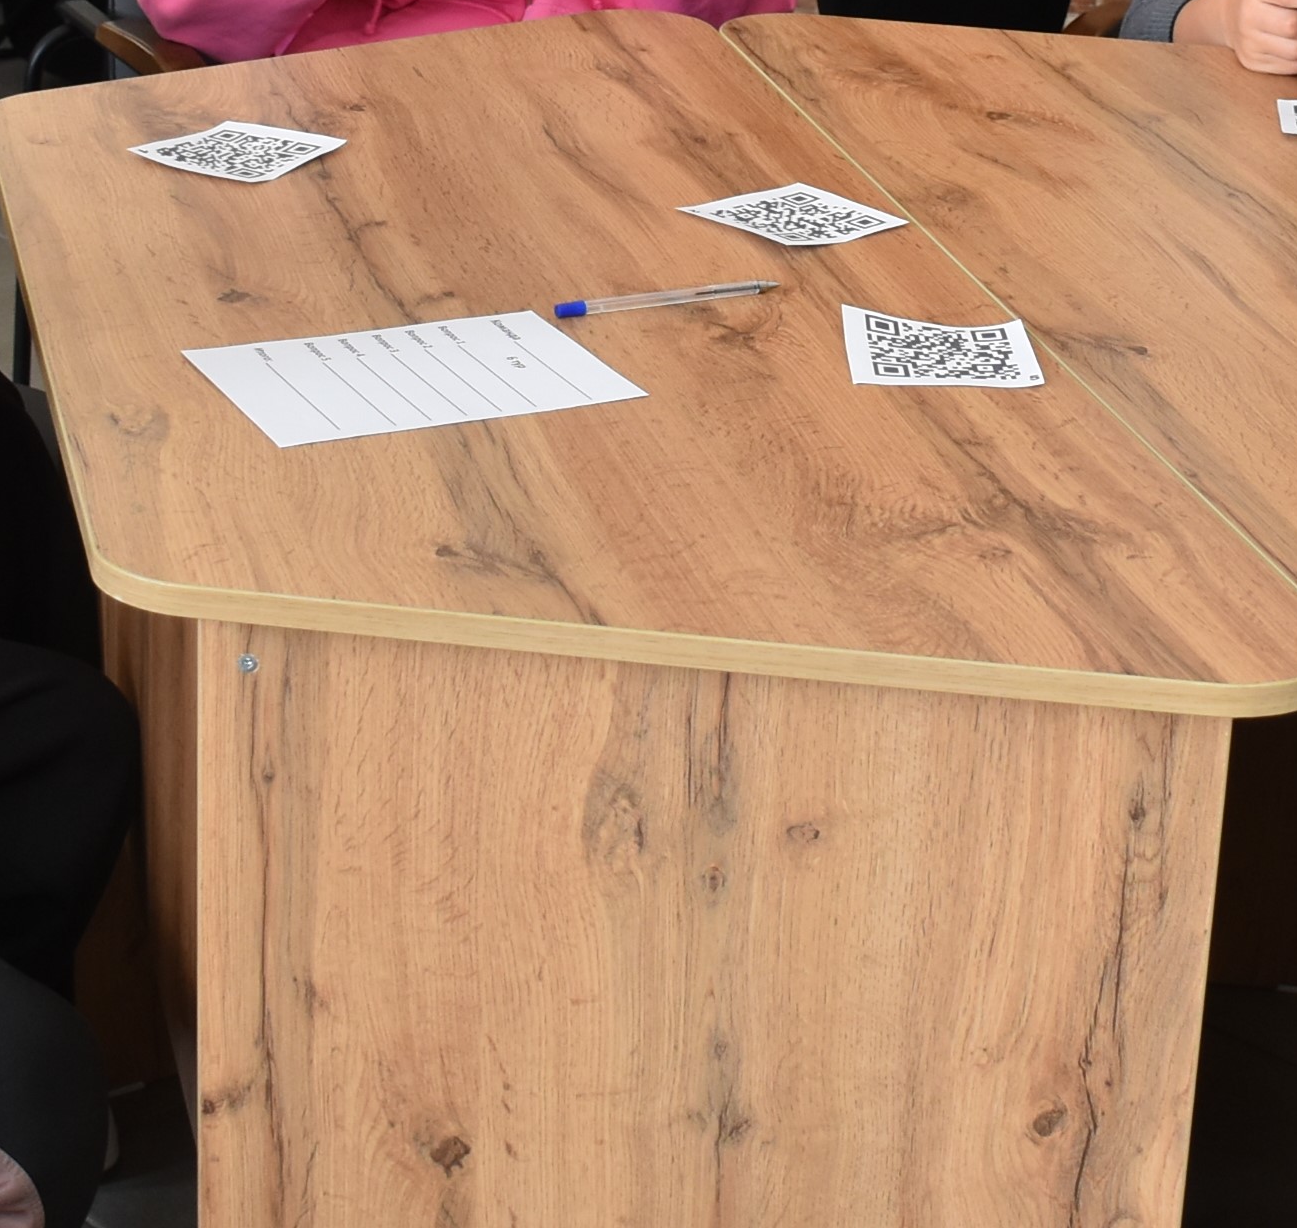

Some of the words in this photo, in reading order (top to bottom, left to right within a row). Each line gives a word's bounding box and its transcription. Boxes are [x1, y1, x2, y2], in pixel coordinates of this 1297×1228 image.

[405, 329, 427, 347] Вопрос
[438, 325, 459, 341] Вопрос
[490, 319, 521, 341] Команда
[304, 342, 326, 359] Вопрос
[338, 338, 360, 355] Вопрос
[371, 334, 394, 351] Вопрос
